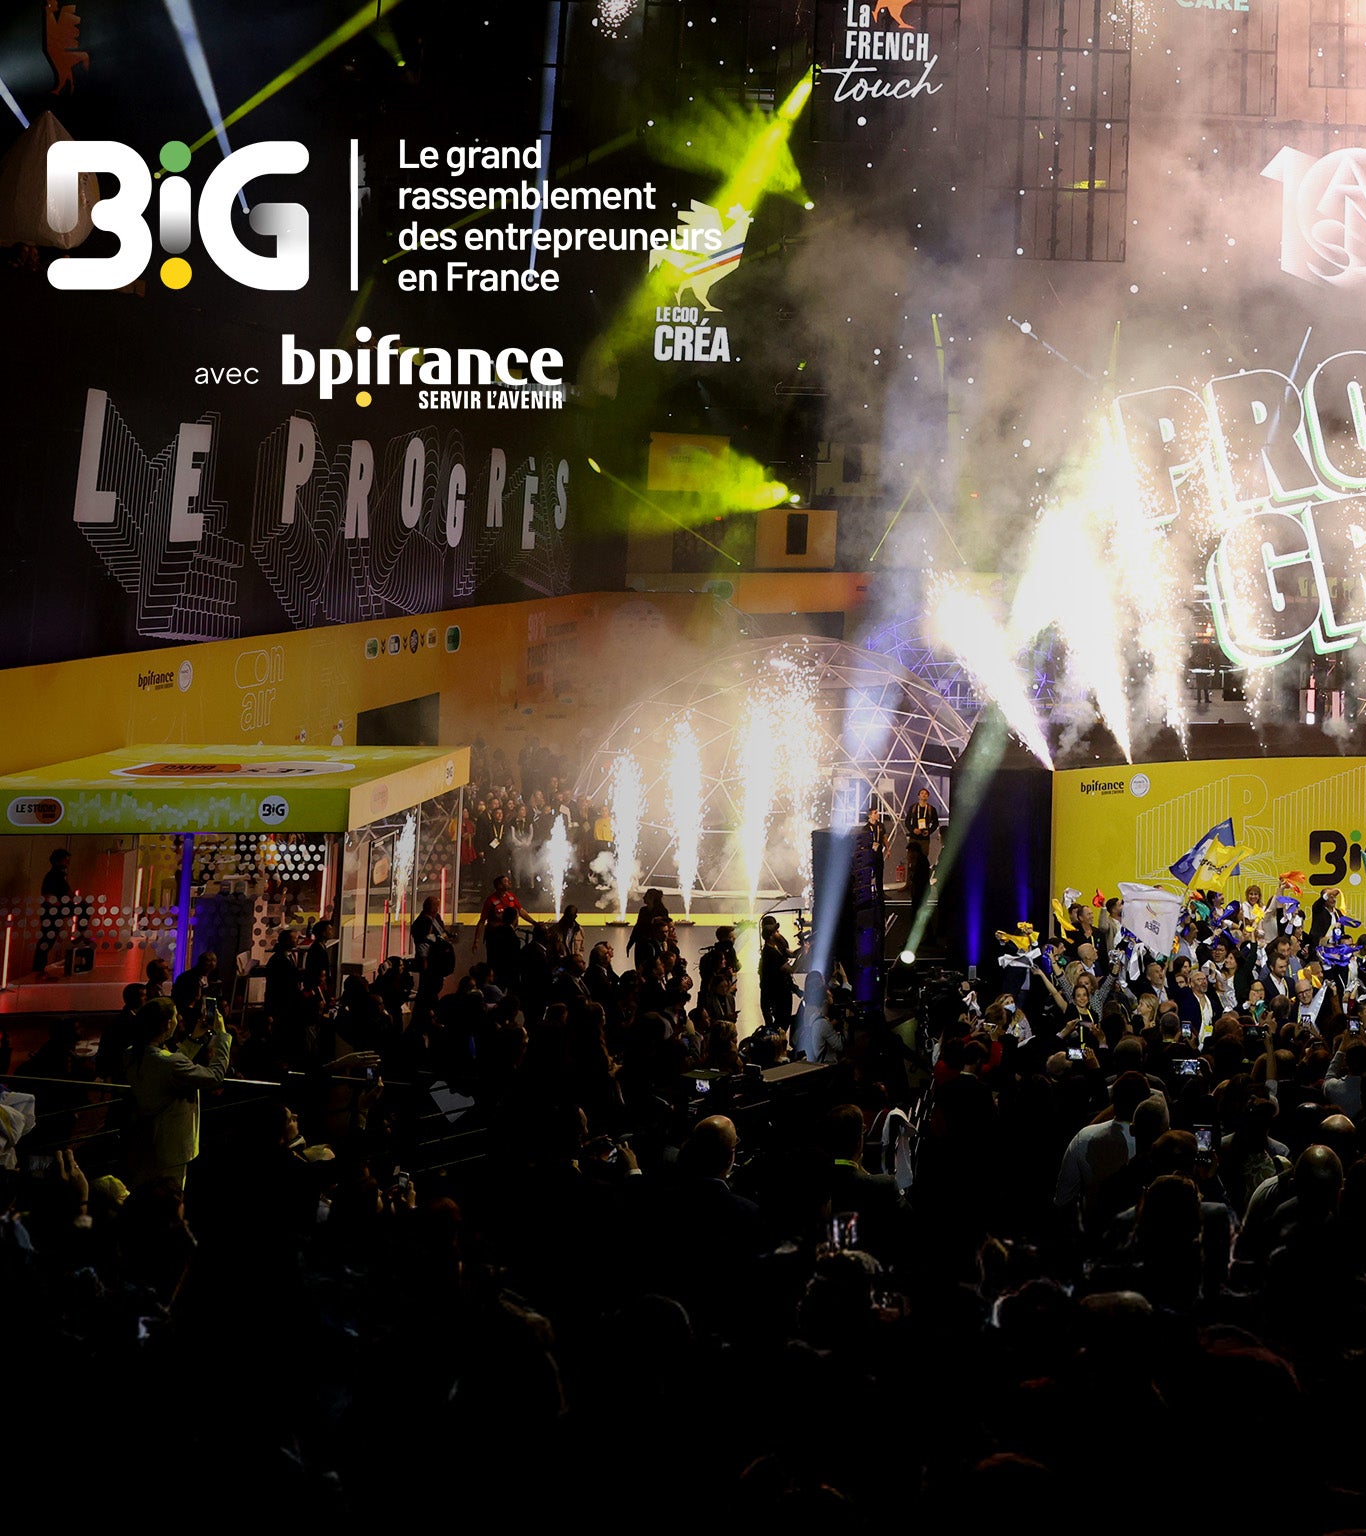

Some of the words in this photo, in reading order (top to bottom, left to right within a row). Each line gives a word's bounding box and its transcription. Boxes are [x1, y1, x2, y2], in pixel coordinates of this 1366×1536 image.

[846, 0, 870, 28] La
[845, 30, 929, 61] FRENCH
[820, 54, 943, 102] touch
[656, 306, 671, 323] LE
[672, 307, 699, 325] COQ
[653, 318, 731, 362] CRÉA
[73, 388, 213, 543] LE
[281, 415, 570, 550] PROGRÈS
[137, 670, 175, 691] bpifrance
[240, 688, 276, 732] air
[1080, 779, 1125, 795] bpifrance
[16, 803, 26, 813] LE
